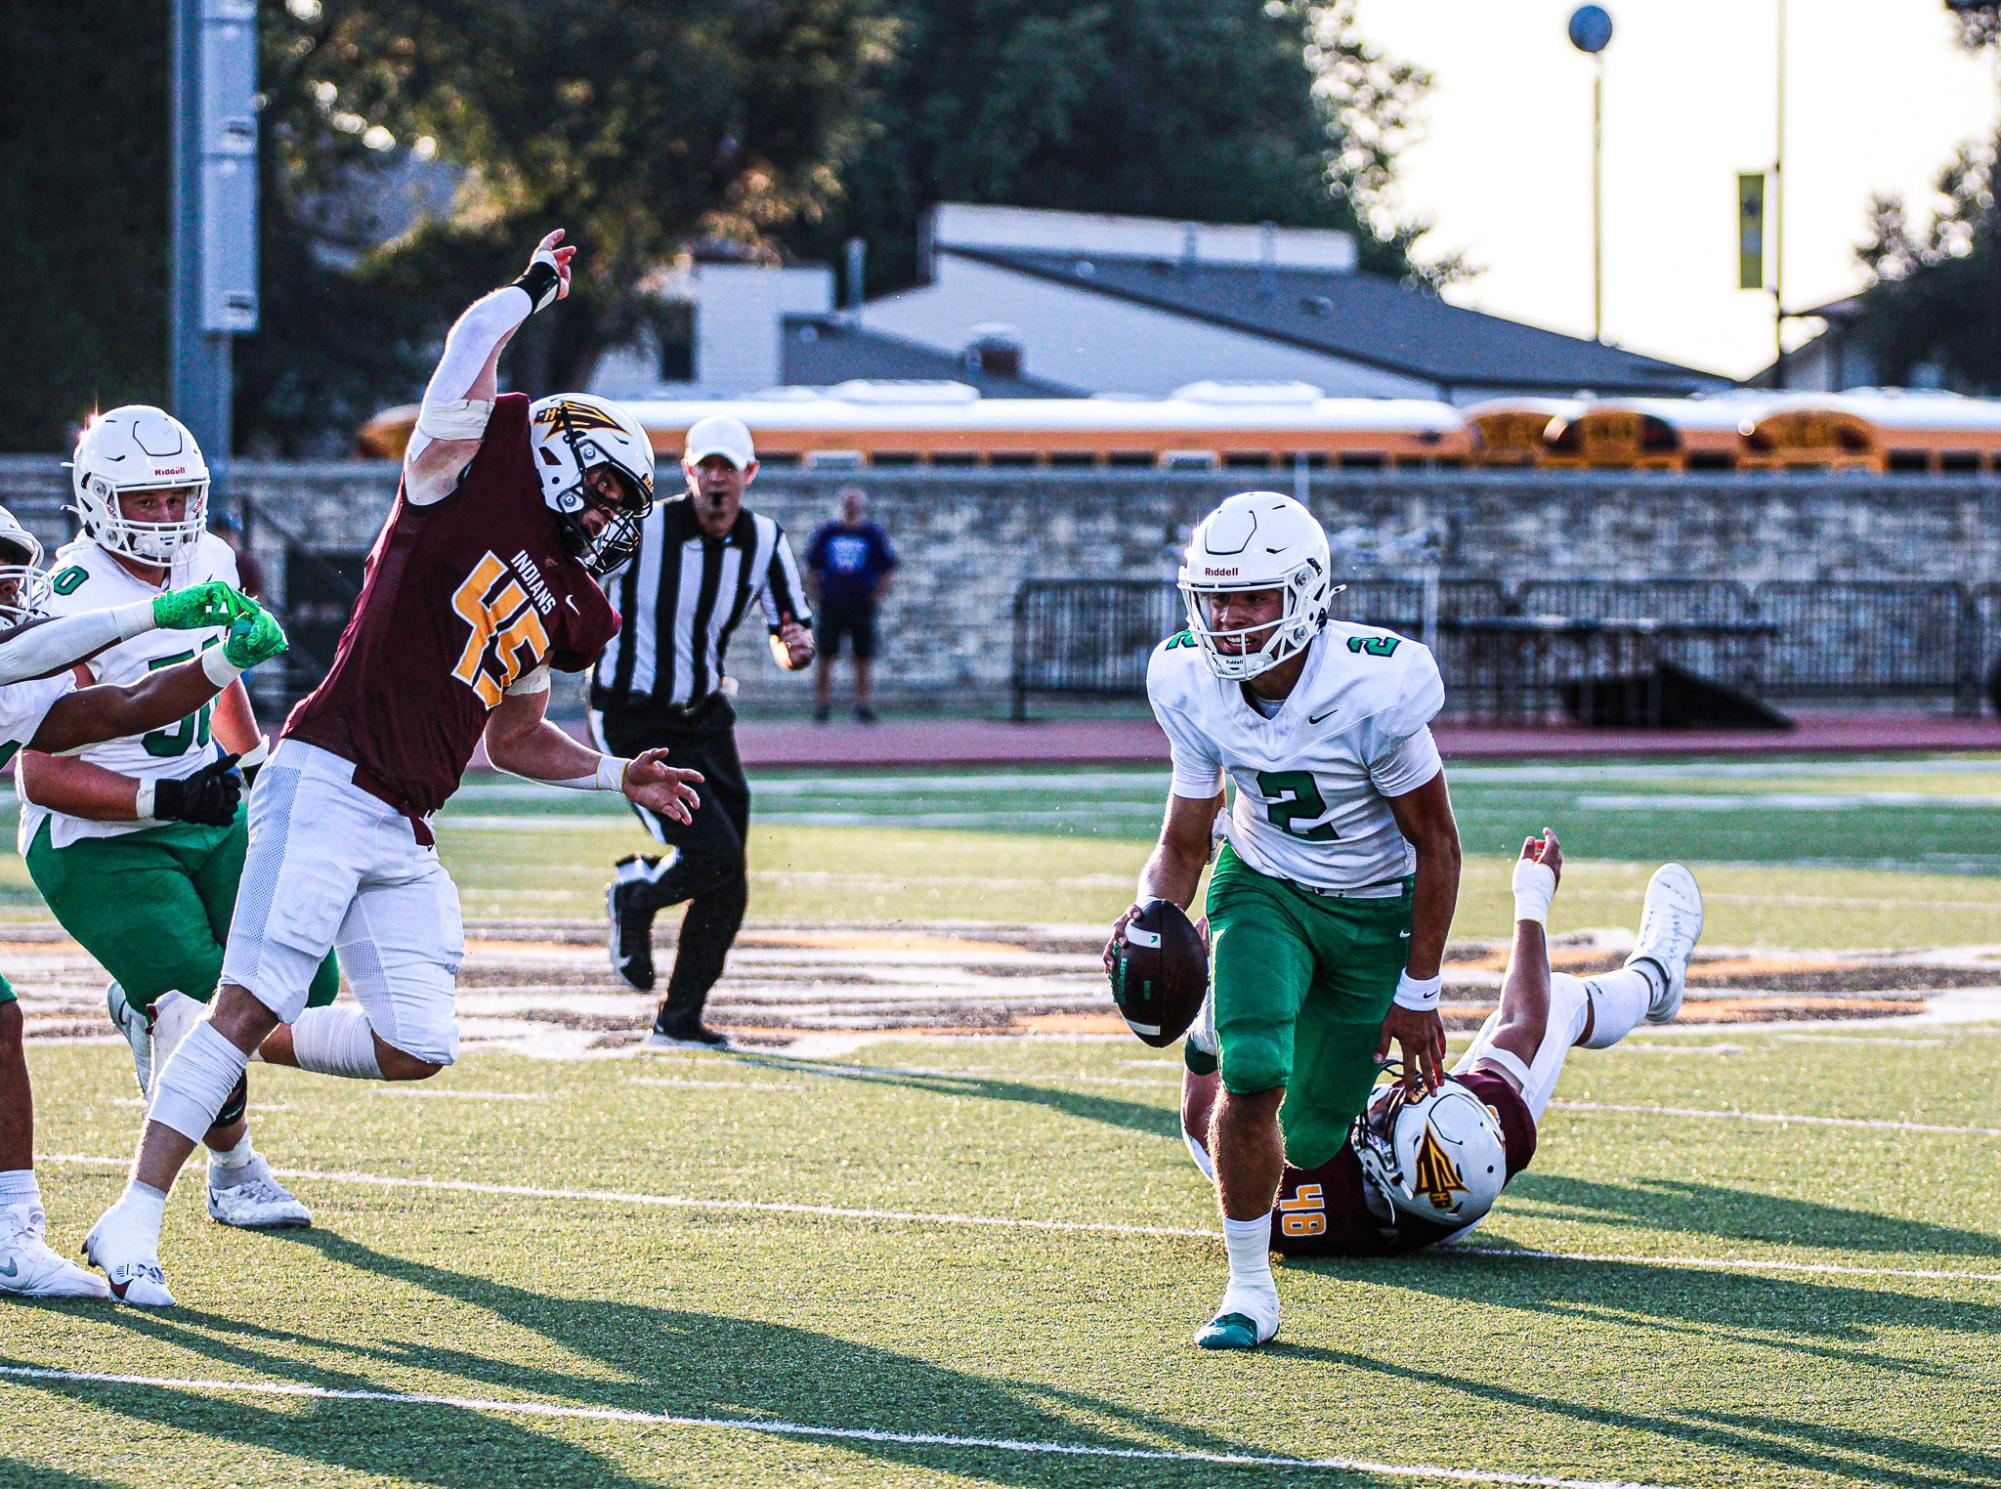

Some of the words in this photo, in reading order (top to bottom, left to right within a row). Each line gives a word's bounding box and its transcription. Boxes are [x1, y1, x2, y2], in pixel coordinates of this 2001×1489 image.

[155, 467, 185, 476] Riddell
[510, 549, 557, 616] INDIANS
[1205, 567, 1239, 577] Riddell
[451, 550, 550, 711] 45
[1346, 636, 1402, 658] 2
[1257, 771, 1342, 841] 2
[1279, 1183, 1326, 1237] 48
